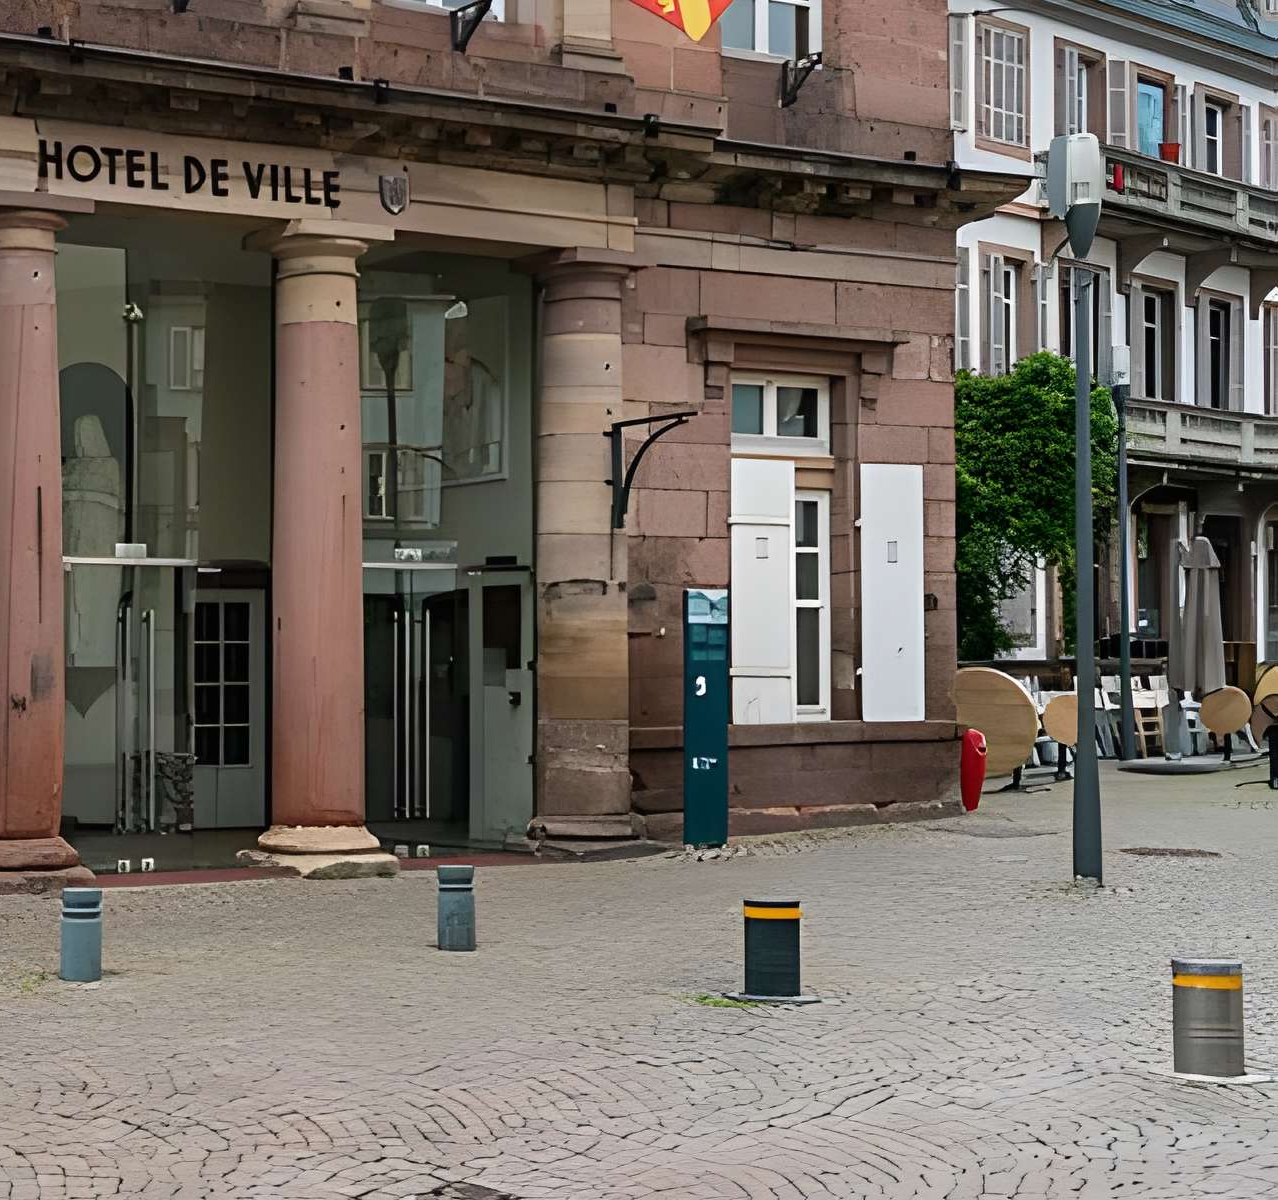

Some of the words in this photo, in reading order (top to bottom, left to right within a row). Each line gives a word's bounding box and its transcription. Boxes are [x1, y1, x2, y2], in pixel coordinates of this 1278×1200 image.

[38, 139, 169, 190] HOTEL
[184, 155, 229, 197] DE
[242, 161, 340, 208] VILLE
